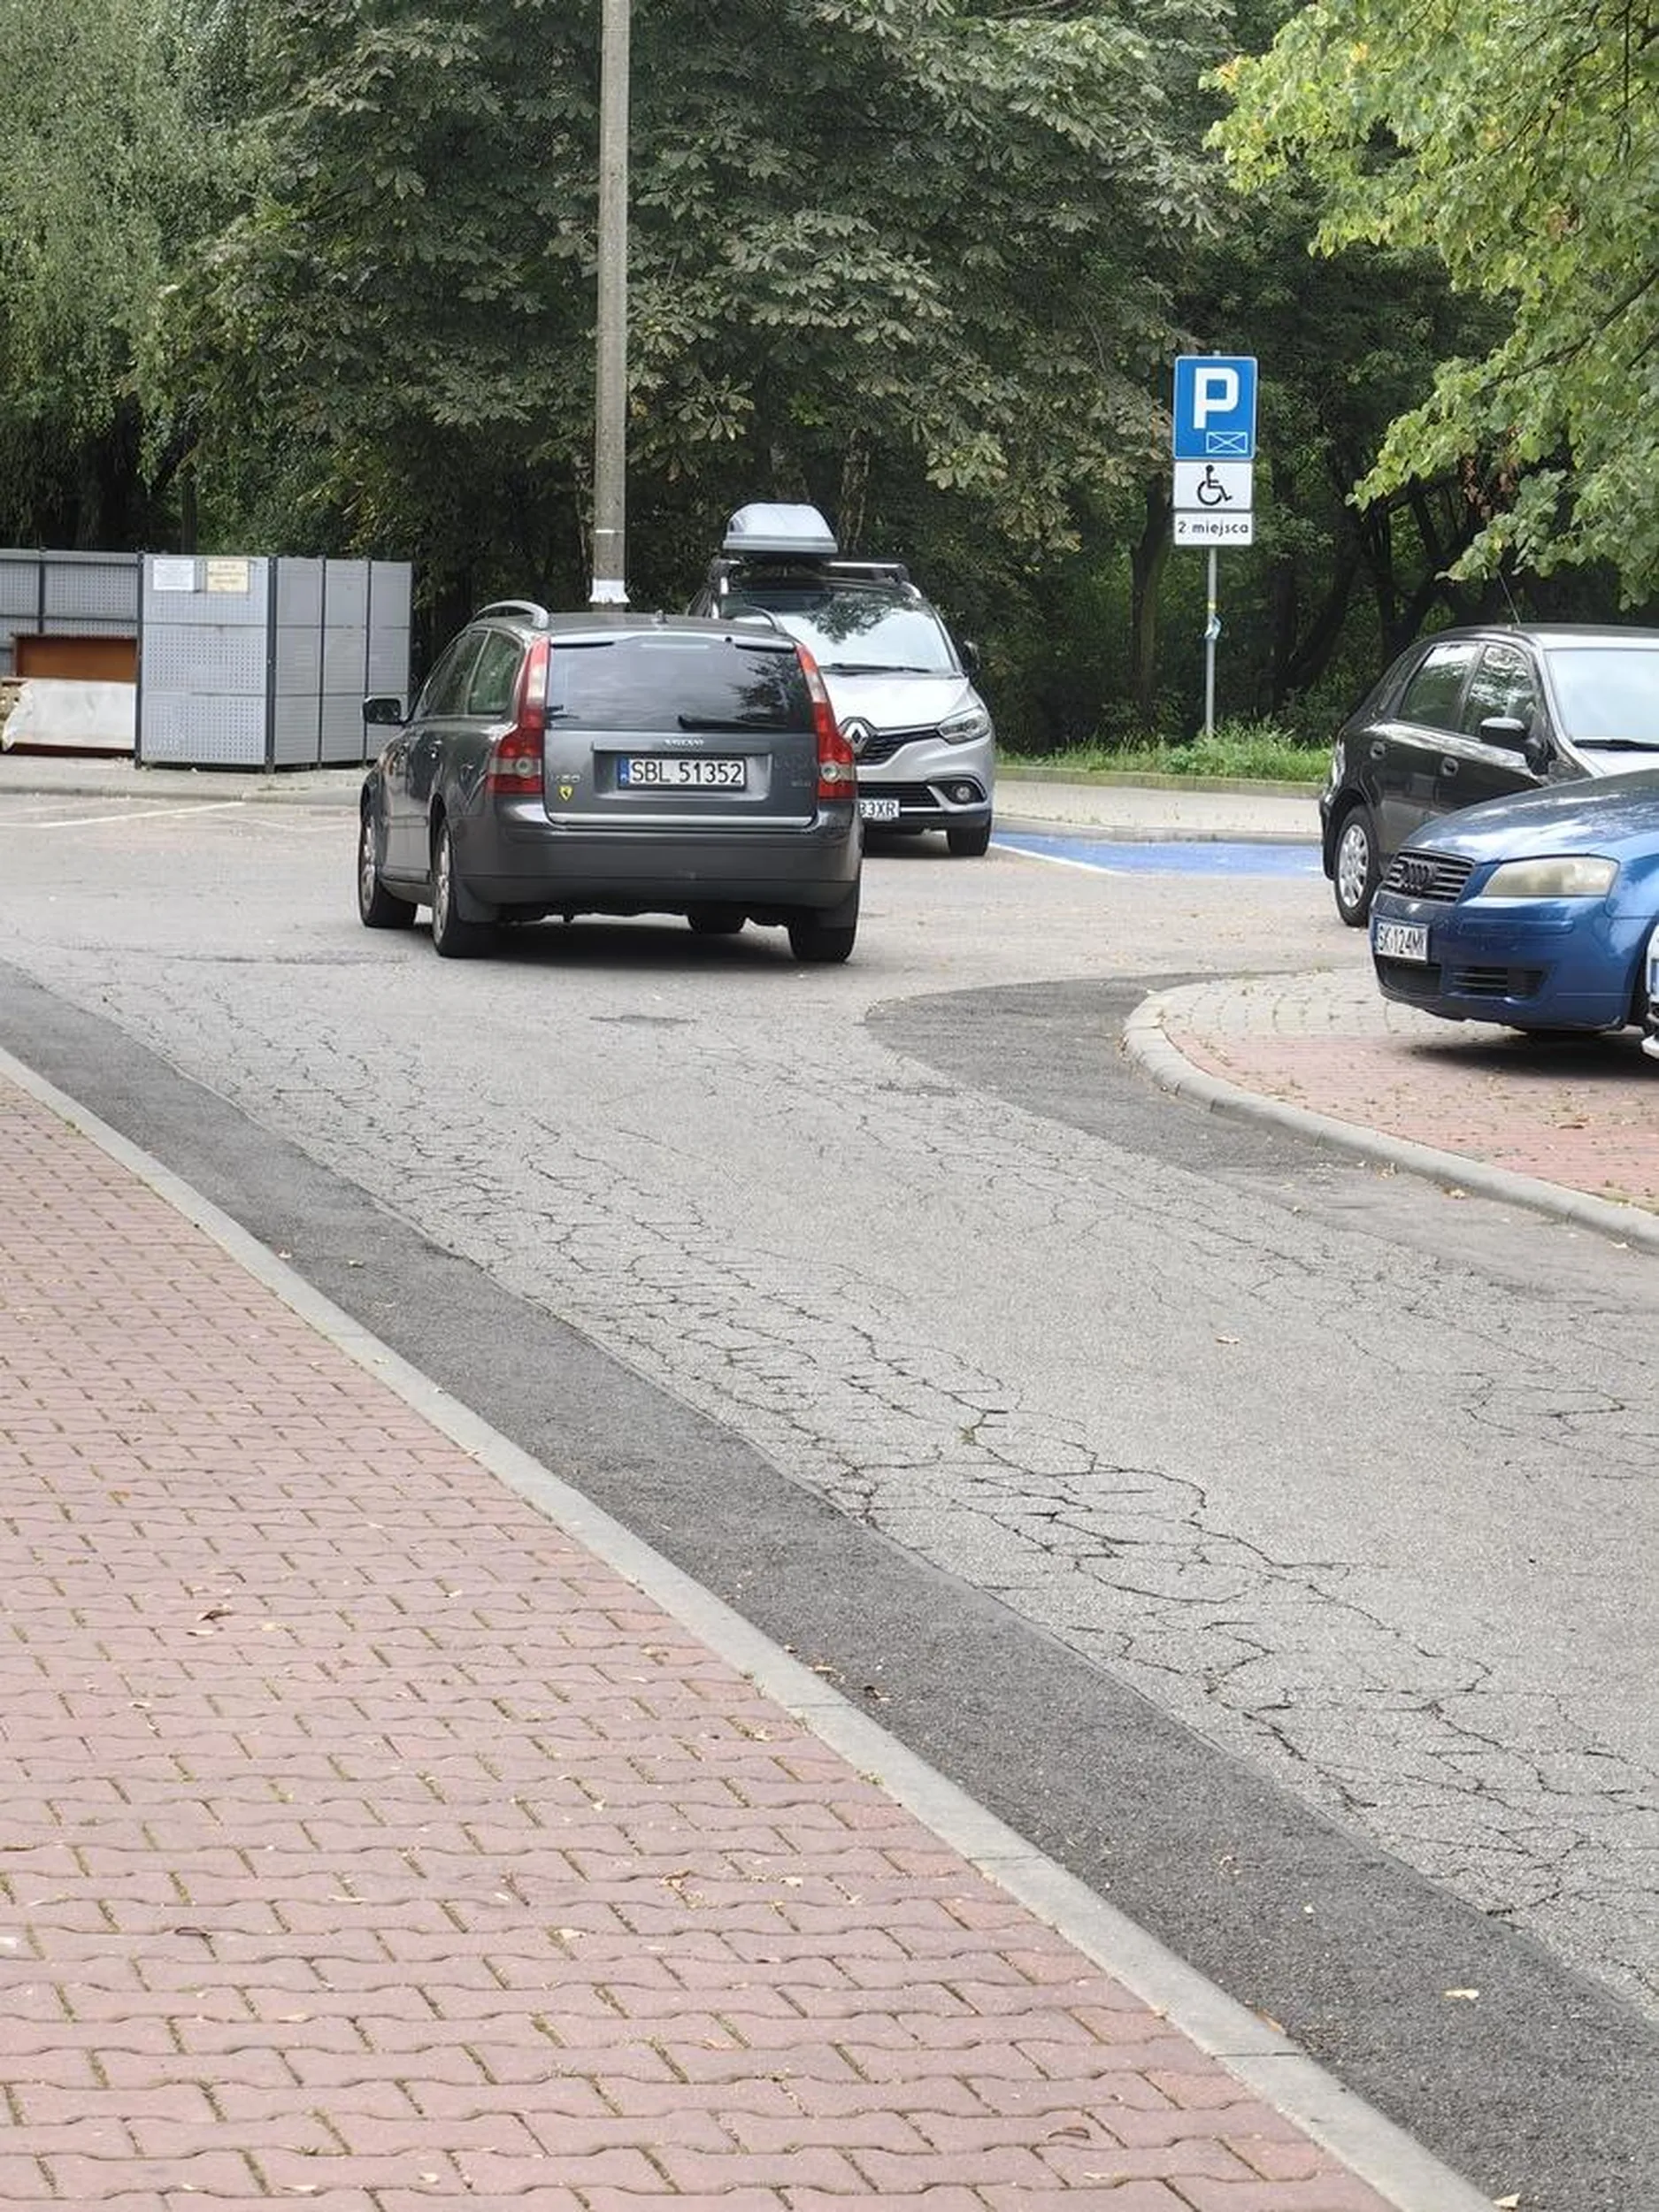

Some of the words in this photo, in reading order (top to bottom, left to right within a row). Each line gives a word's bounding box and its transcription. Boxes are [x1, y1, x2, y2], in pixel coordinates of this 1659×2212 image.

[1193, 367, 1239, 429] P
[1178, 520, 1187, 534] 2
[1191, 518, 1249, 537] miejsca
[631, 760, 672, 782] SBL
[678, 761, 741, 784] 51352
